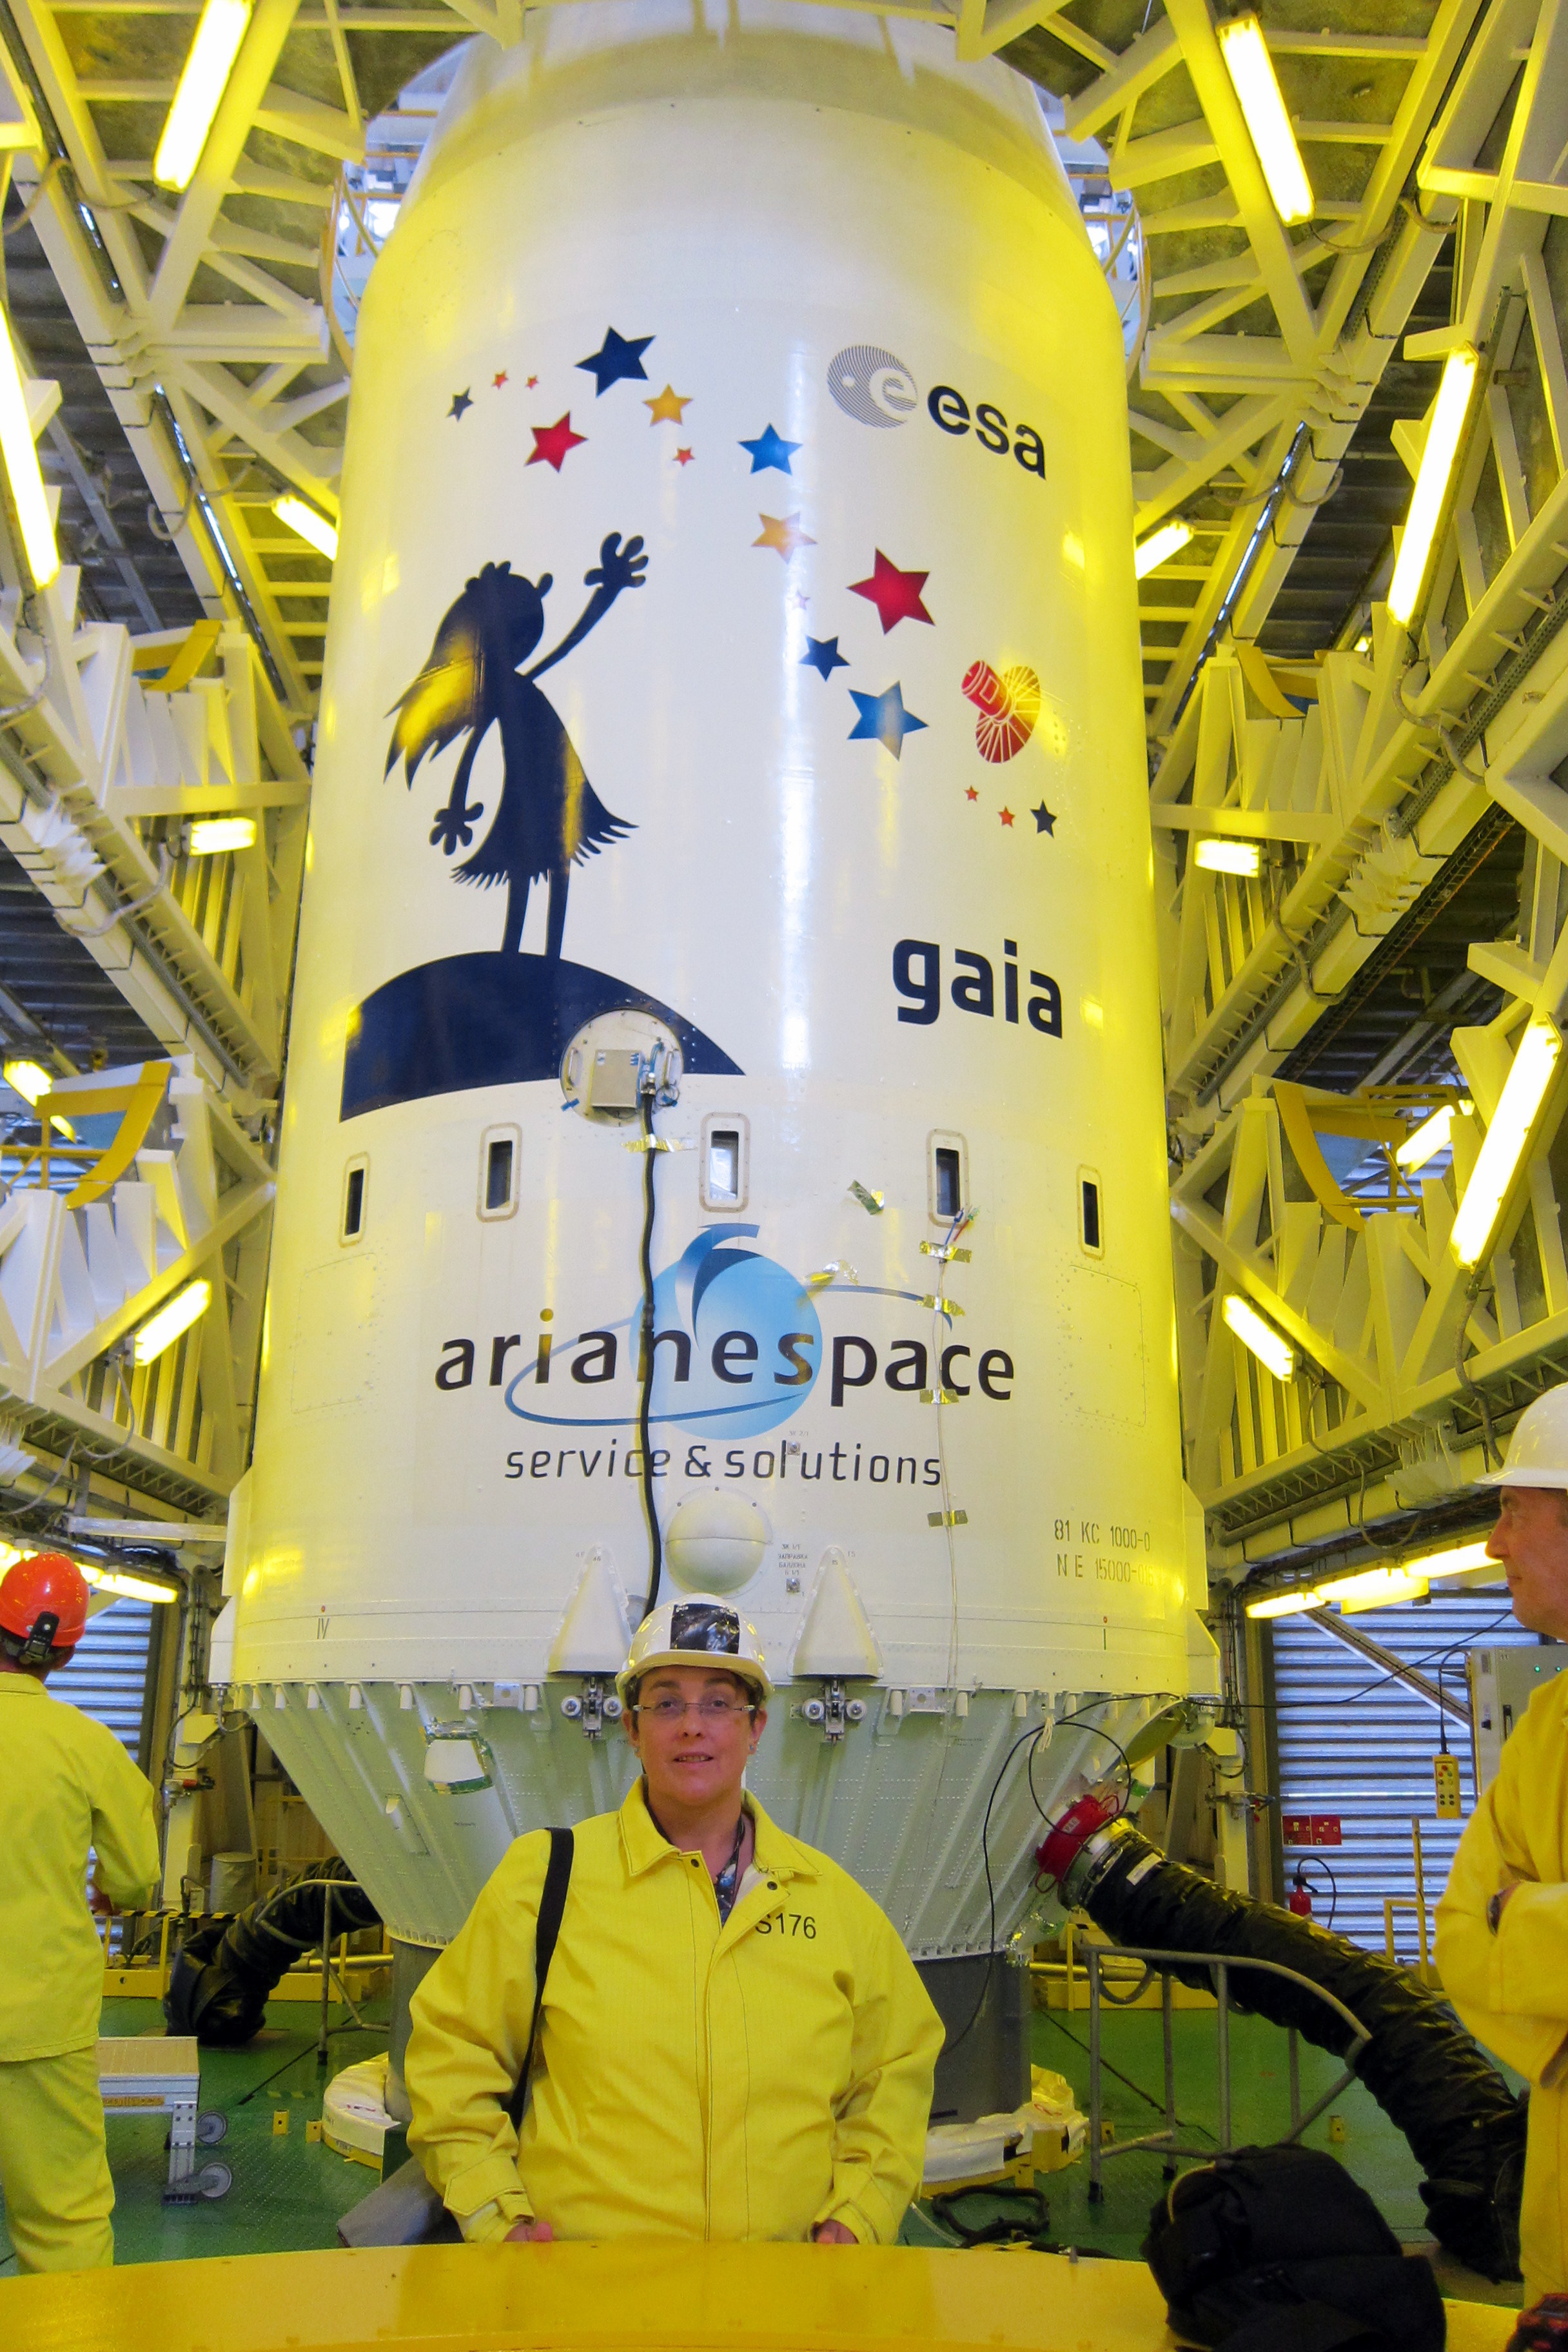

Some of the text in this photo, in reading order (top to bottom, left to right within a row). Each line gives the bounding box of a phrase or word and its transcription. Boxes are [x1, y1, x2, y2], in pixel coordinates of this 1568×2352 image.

[927, 385, 1046, 480] esa
[892, 938, 1063, 1039] gaia
[435, 1308, 1014, 1407] arianespace
[504, 1439, 941, 1485] service & solutions
[1054, 1518, 1150, 1552] 81 KC 1000-0
[755, 1912, 817, 1939] S176
